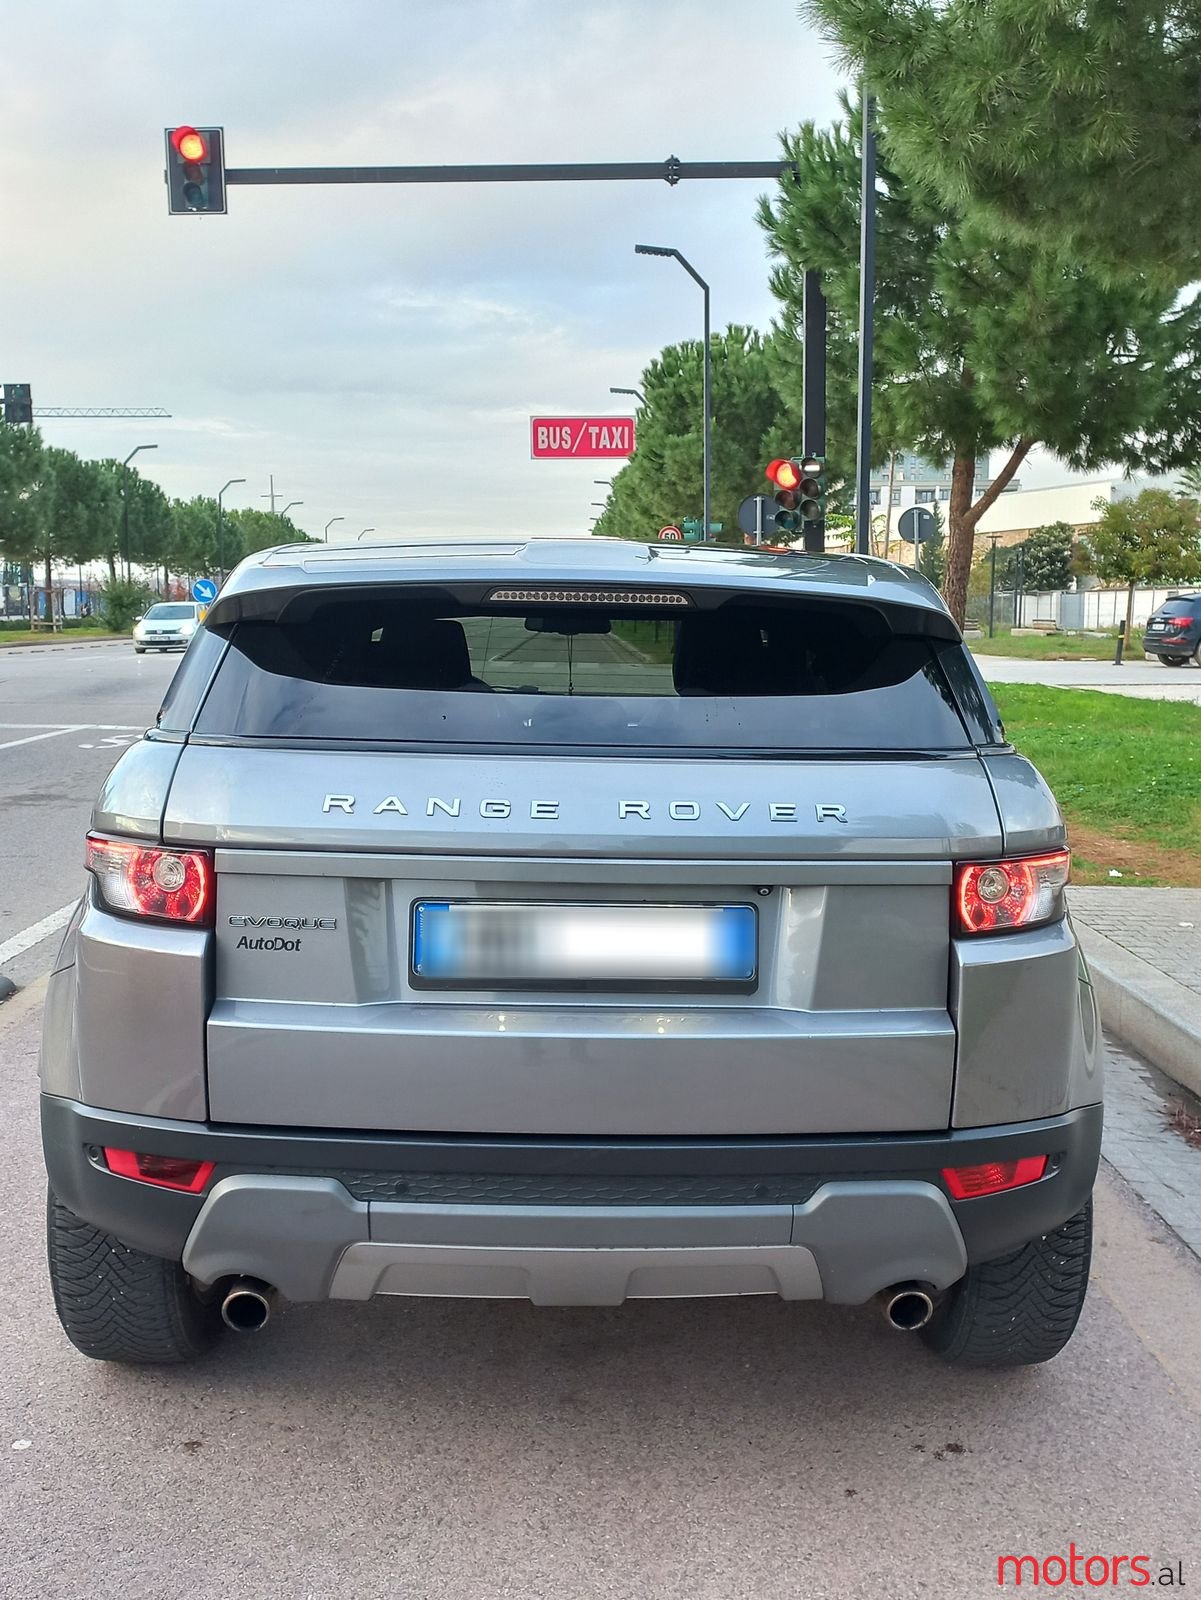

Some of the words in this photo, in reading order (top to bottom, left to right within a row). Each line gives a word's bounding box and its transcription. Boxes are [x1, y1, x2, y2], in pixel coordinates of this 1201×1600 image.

[537, 422, 629, 453] BUS/TAXI
[664, 532, 676, 540] 50
[321, 794, 560, 819] RANGE
[618, 800, 848, 823] ROVER
[228, 915, 337, 931] EVOQUE
[236, 936, 302, 952] AutoDot
